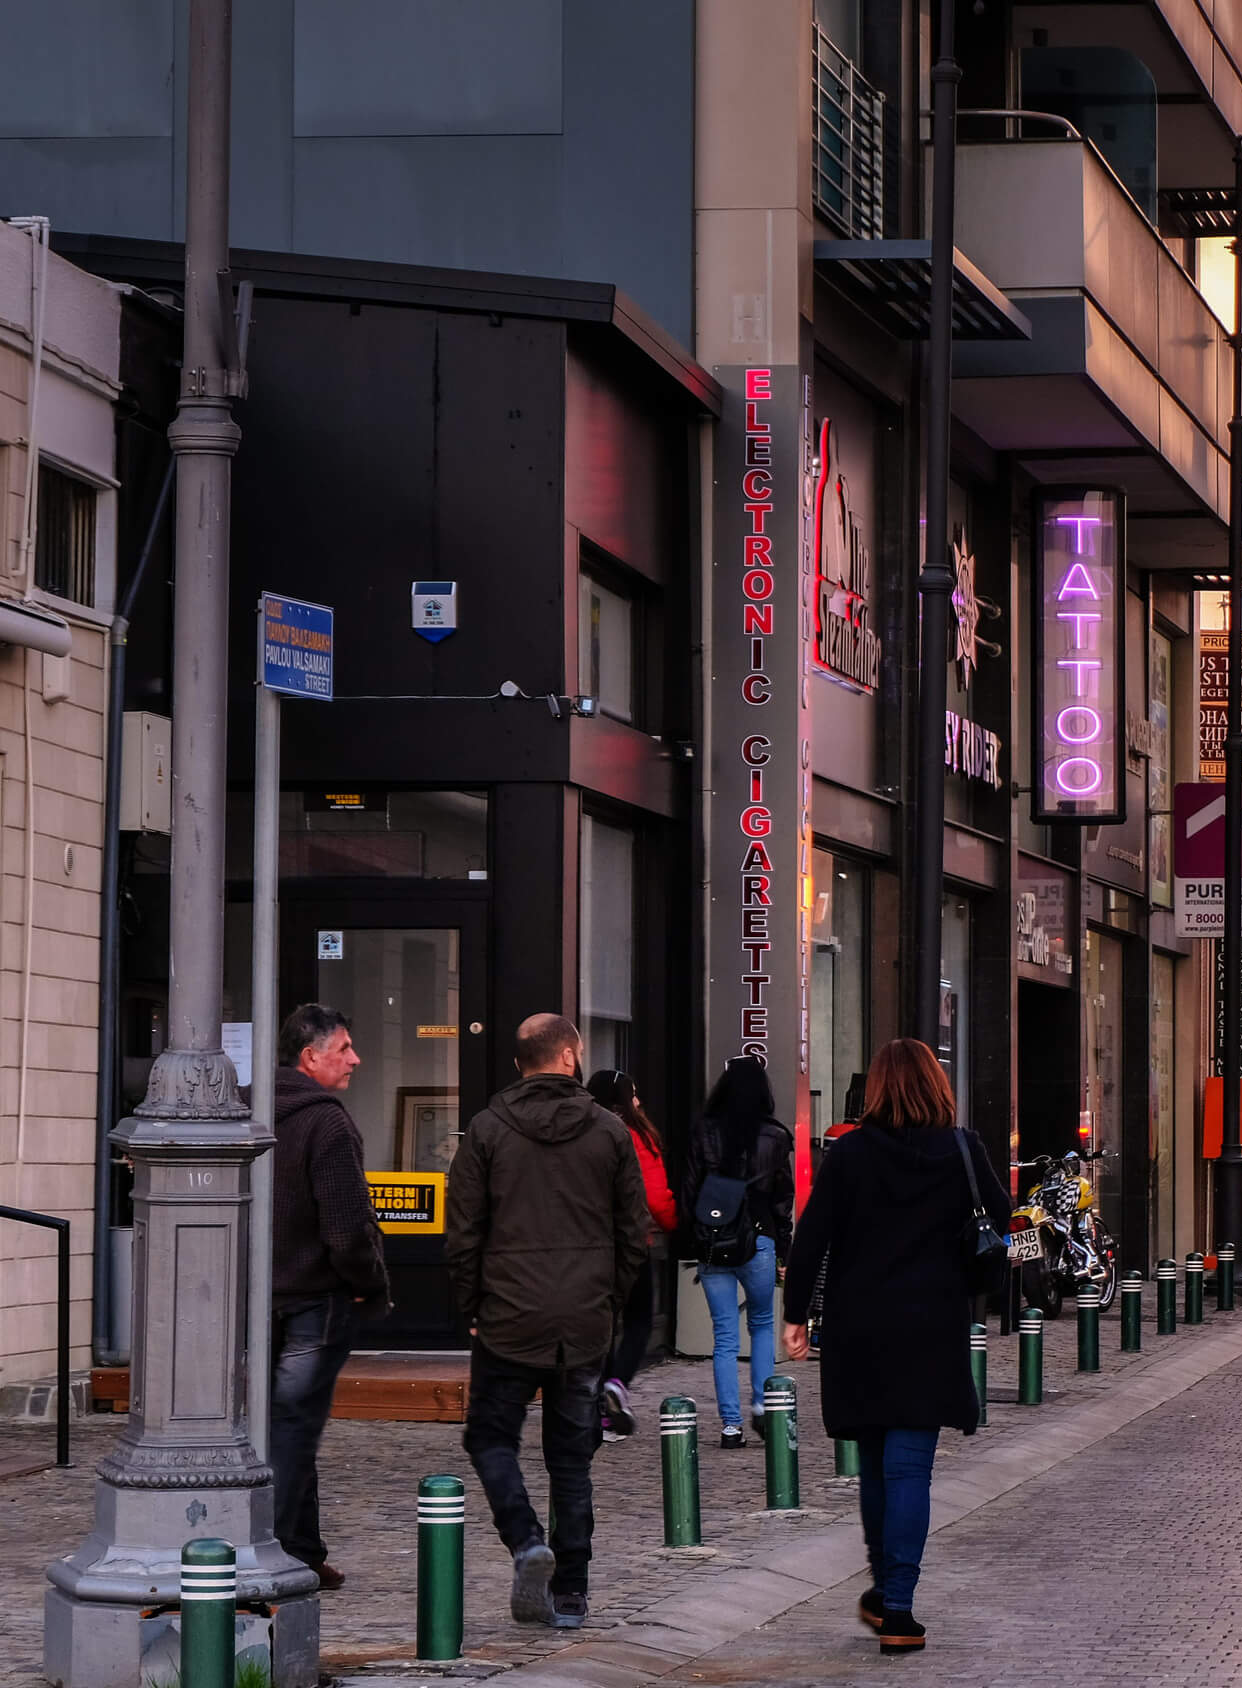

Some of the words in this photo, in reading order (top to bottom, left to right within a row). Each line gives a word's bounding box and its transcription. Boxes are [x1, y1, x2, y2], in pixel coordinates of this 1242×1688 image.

[742, 368, 774, 706] ELECTRONIC
[1203, 637, 1242, 648] PRIC
[265, 644, 291, 668] PAVLOU
[292, 649, 330, 676] VALSAMAKI
[1056, 516, 1102, 793] TATTOO
[305, 673, 330, 693] STREET
[1185, 914, 1193, 923] T
[384, 1212, 428, 1220] TRANSFER
[1011, 1230, 1037, 1247] HNB
[1016, 1243, 1039, 1258] 429
